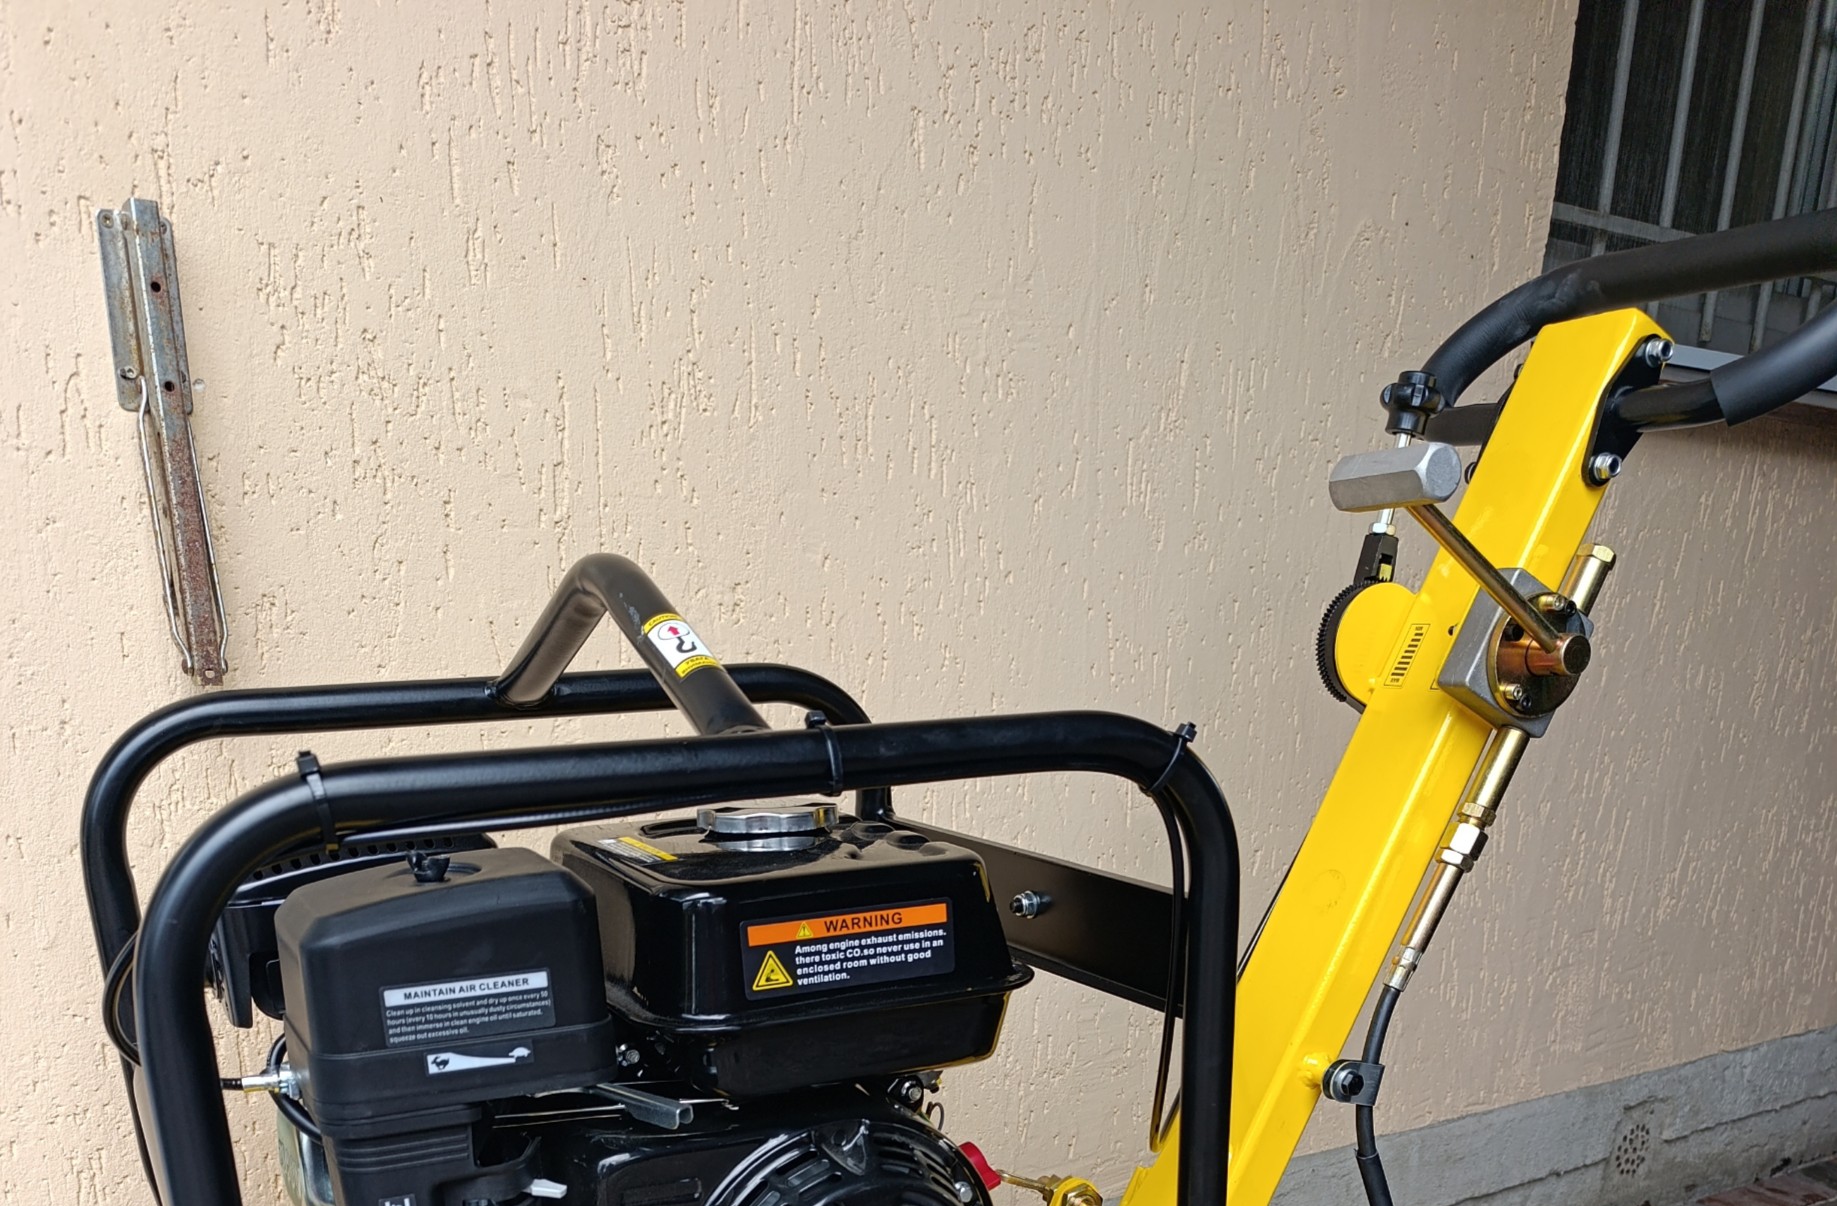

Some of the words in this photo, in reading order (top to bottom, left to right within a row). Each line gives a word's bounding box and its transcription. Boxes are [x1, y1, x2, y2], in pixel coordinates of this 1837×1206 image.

[824, 912, 903, 933] WARNING
[795, 944, 827, 954] Among
[829, 939, 860, 950] engine
[861, 933, 897, 945] exhaust
[898, 929, 946, 941] emissions.
[795, 955, 820, 965] there
[821, 951, 845, 961] toxic
[876, 944, 902, 954] never
[903, 942, 920, 951] use
[922, 940, 930, 948] in
[932, 939, 943, 947] an
[797, 961, 841, 975] enclosed
[842, 959, 867, 969] room
[869, 953, 905, 965] without
[907, 949, 931, 962] good
[403, 987, 456, 1000] MAINTAIN
[458, 984, 476, 994] AIR
[479, 977, 529, 991] CLEANER
[797, 972, 850, 985] ventilation.
[386, 1009, 404, 1017] Clean
[421, 1003, 452, 1012] cleansing
[452, 1000, 475, 1009] solvent
[488, 997, 498, 1005] dry
[387, 1018, 405, 1026] hours
[459, 1006, 488, 1016] unusually
[489, 1005, 505, 1013] dusty
[416, 1022, 443, 1030] immerse
[468, 1016, 488, 1024] engine
[499, 1012, 512, 1020] until
[428, 1028, 458, 1038] excessive
